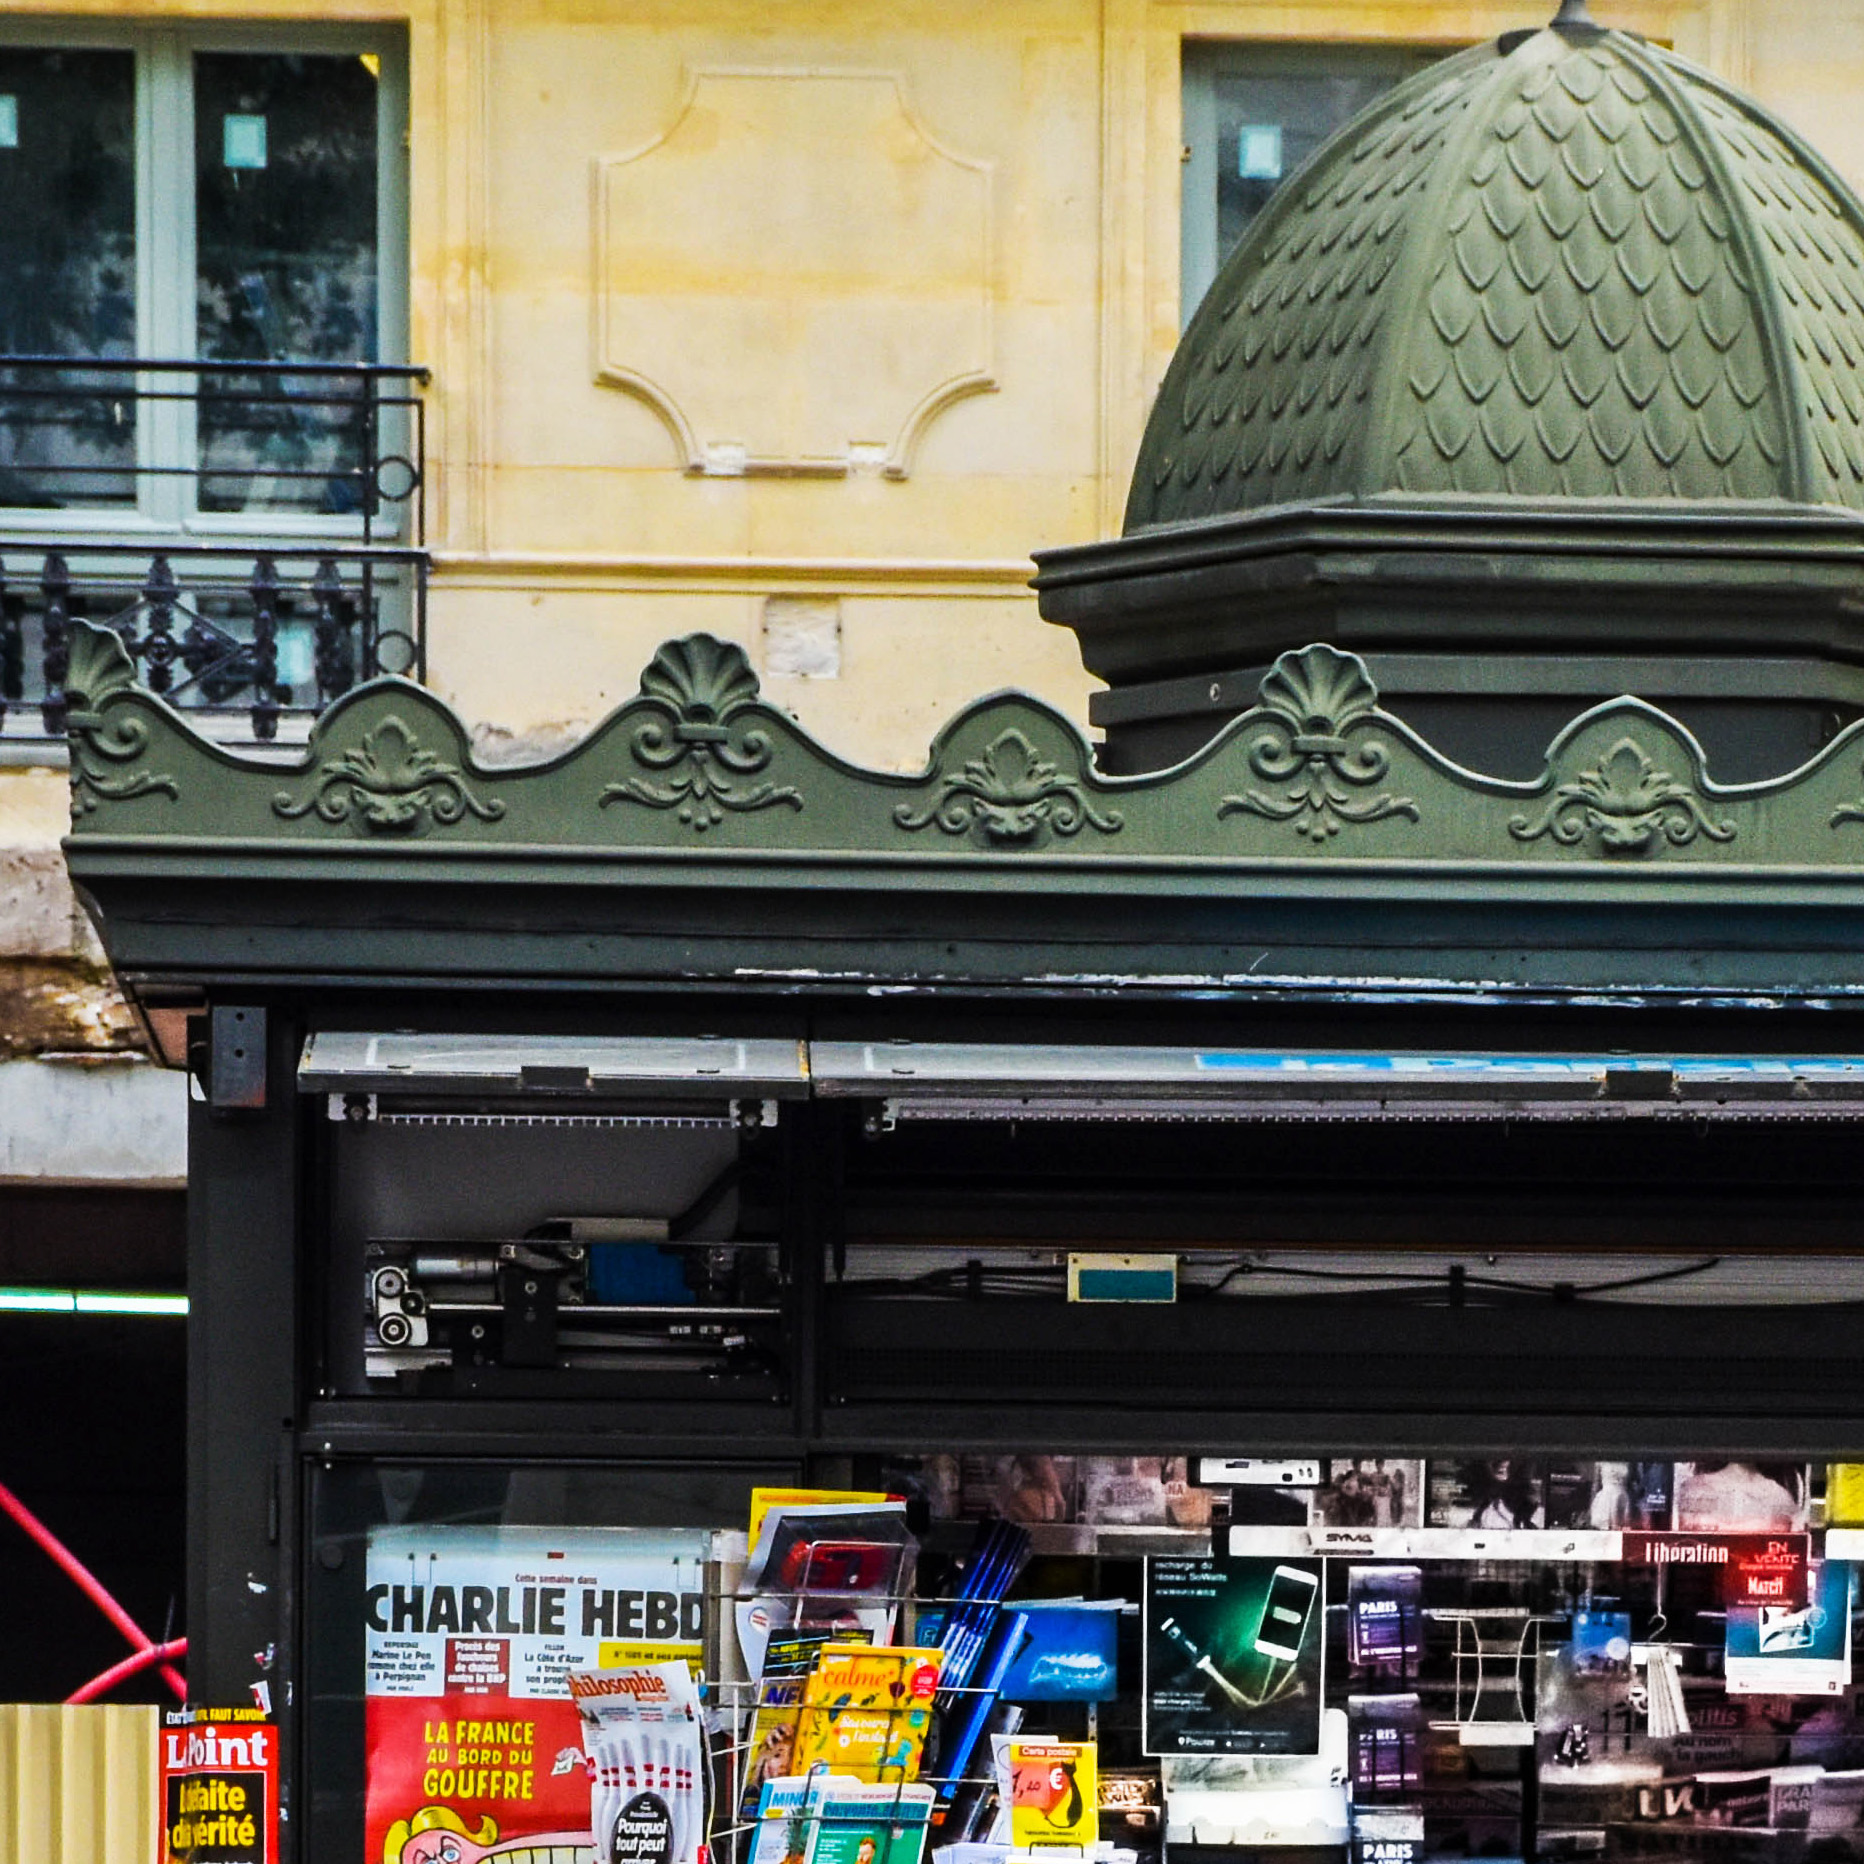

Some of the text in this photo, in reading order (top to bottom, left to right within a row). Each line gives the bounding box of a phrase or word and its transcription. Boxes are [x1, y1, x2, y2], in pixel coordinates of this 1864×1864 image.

[515, 1574, 597, 1585] Cette semaine dans
[365, 1584, 565, 1635] CHARLIE
[1359, 1600, 1397, 1615] PARIS
[372, 1650, 431, 1660] Marine Le Pen
[525, 1652, 584, 1663] La Côte d'Azur
[383, 1672, 426, 1682] Perpignan
[824, 1656, 886, 1687] calme
[209, 1708, 232, 1721] FAUT
[425, 1720, 535, 1745] LA FRANCE
[427, 1749, 532, 1765] AU BORD DU
[1022, 1746, 1077, 1760] Carte postale
[424, 1768, 533, 1800] GOUFFRE
[1049, 1767, 1063, 1790] €
[618, 1818, 667, 1840] Pourquoi
[616, 1838, 666, 1857] tout peut
[1362, 1844, 1413, 1859] PARIS
